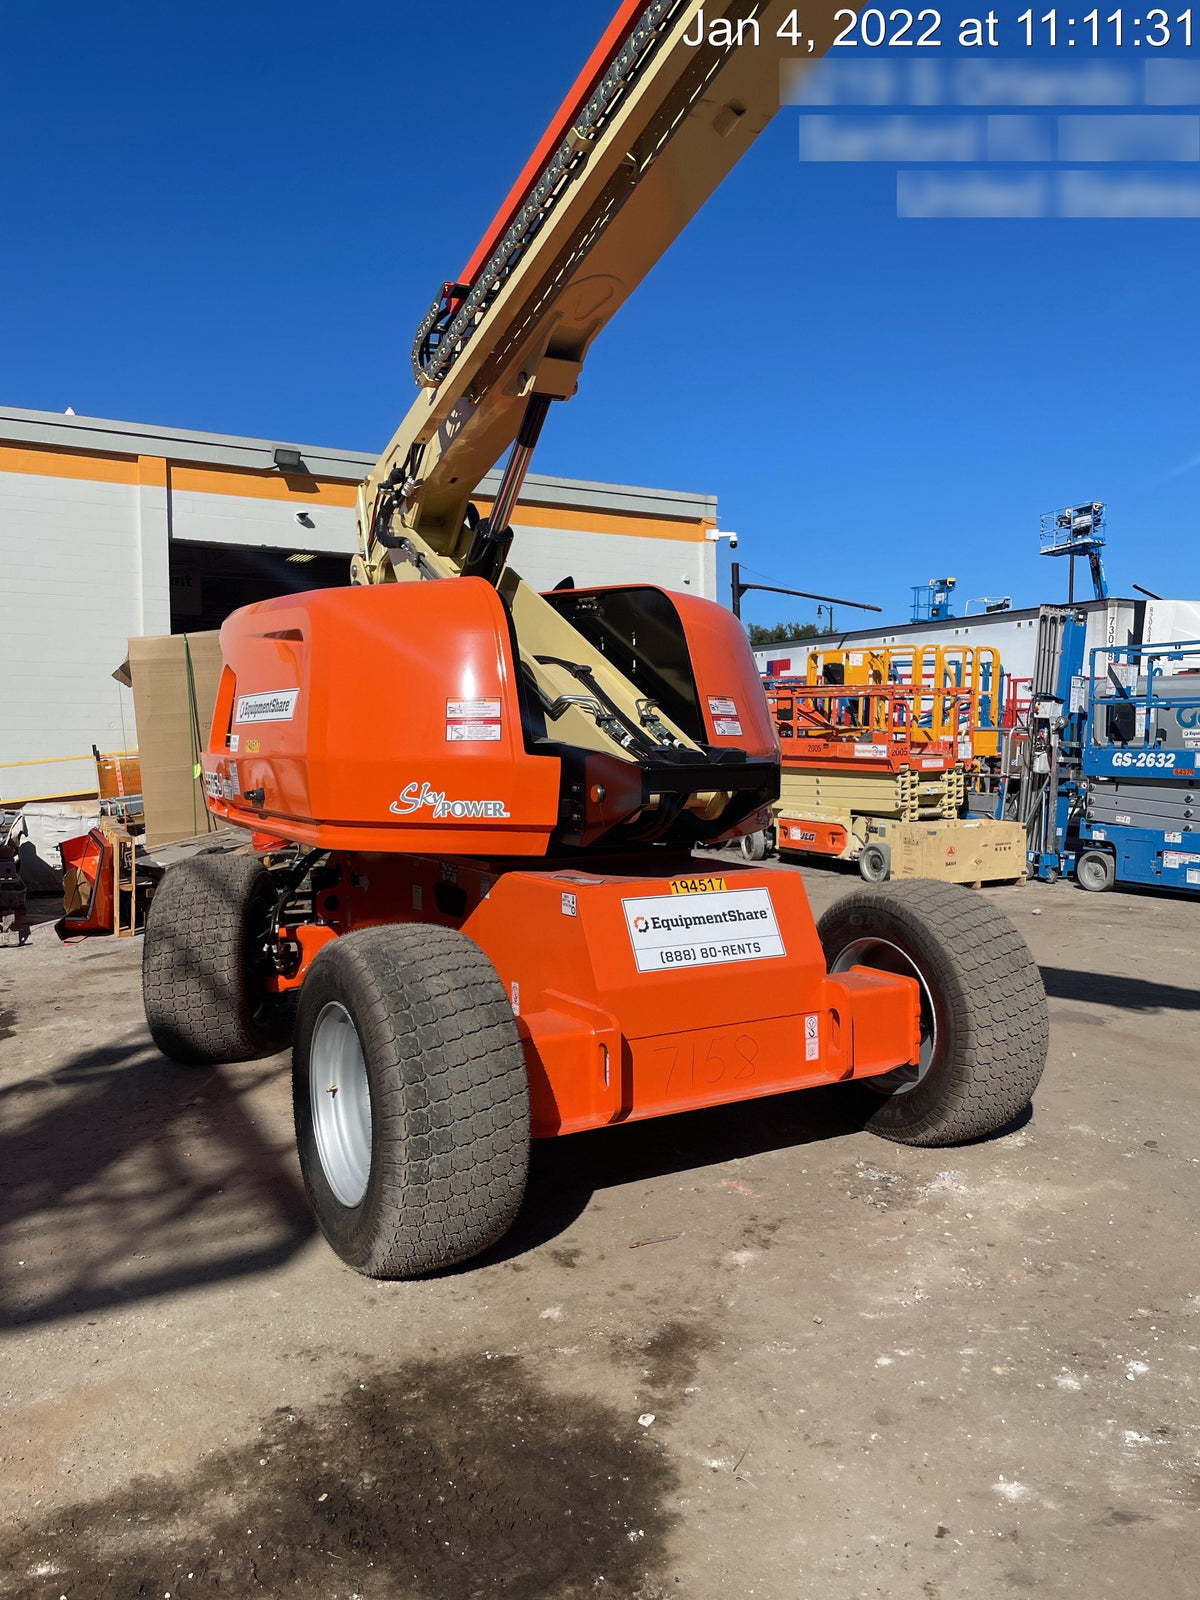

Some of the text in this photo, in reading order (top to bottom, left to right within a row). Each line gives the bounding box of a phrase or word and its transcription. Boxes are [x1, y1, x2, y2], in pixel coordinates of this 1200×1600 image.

[1107, 616, 1116, 662] 7308
[243, 697, 290, 719] EquipmentShare
[807, 744, 822, 753] 2005
[891, 747, 909, 757] 2005
[1111, 752, 1176, 768] GS-2632
[801, 832, 815, 842] JLG
[671, 877, 724, 894] 194517
[650, 909, 768, 930] EquipmentShare
[660, 942, 762, 964] (888) 80-RENTS
[652, 1034, 759, 1095] 7158
